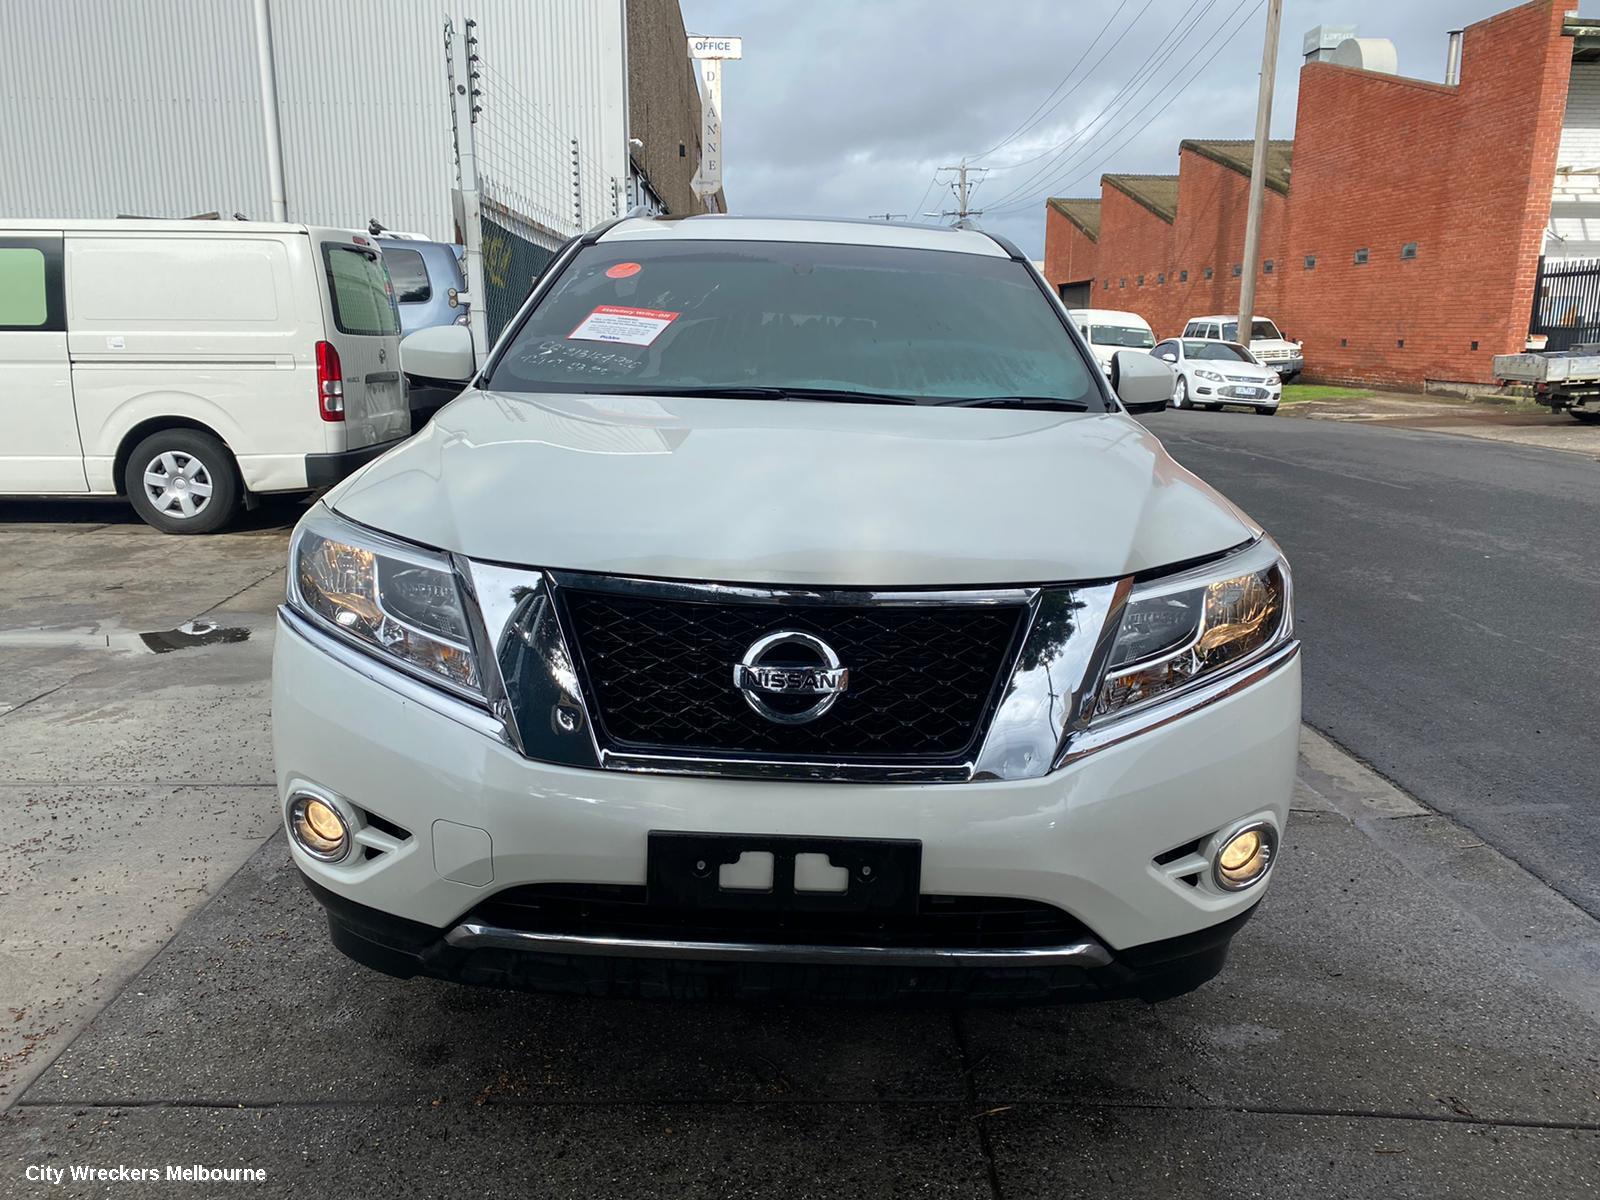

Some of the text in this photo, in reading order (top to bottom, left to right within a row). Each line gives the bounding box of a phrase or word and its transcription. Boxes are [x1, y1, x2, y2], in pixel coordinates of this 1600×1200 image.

[695, 41, 731, 51] OFFICE
[706, 71, 717, 171] DIANNE
[745, 668, 836, 689] NISSAN
